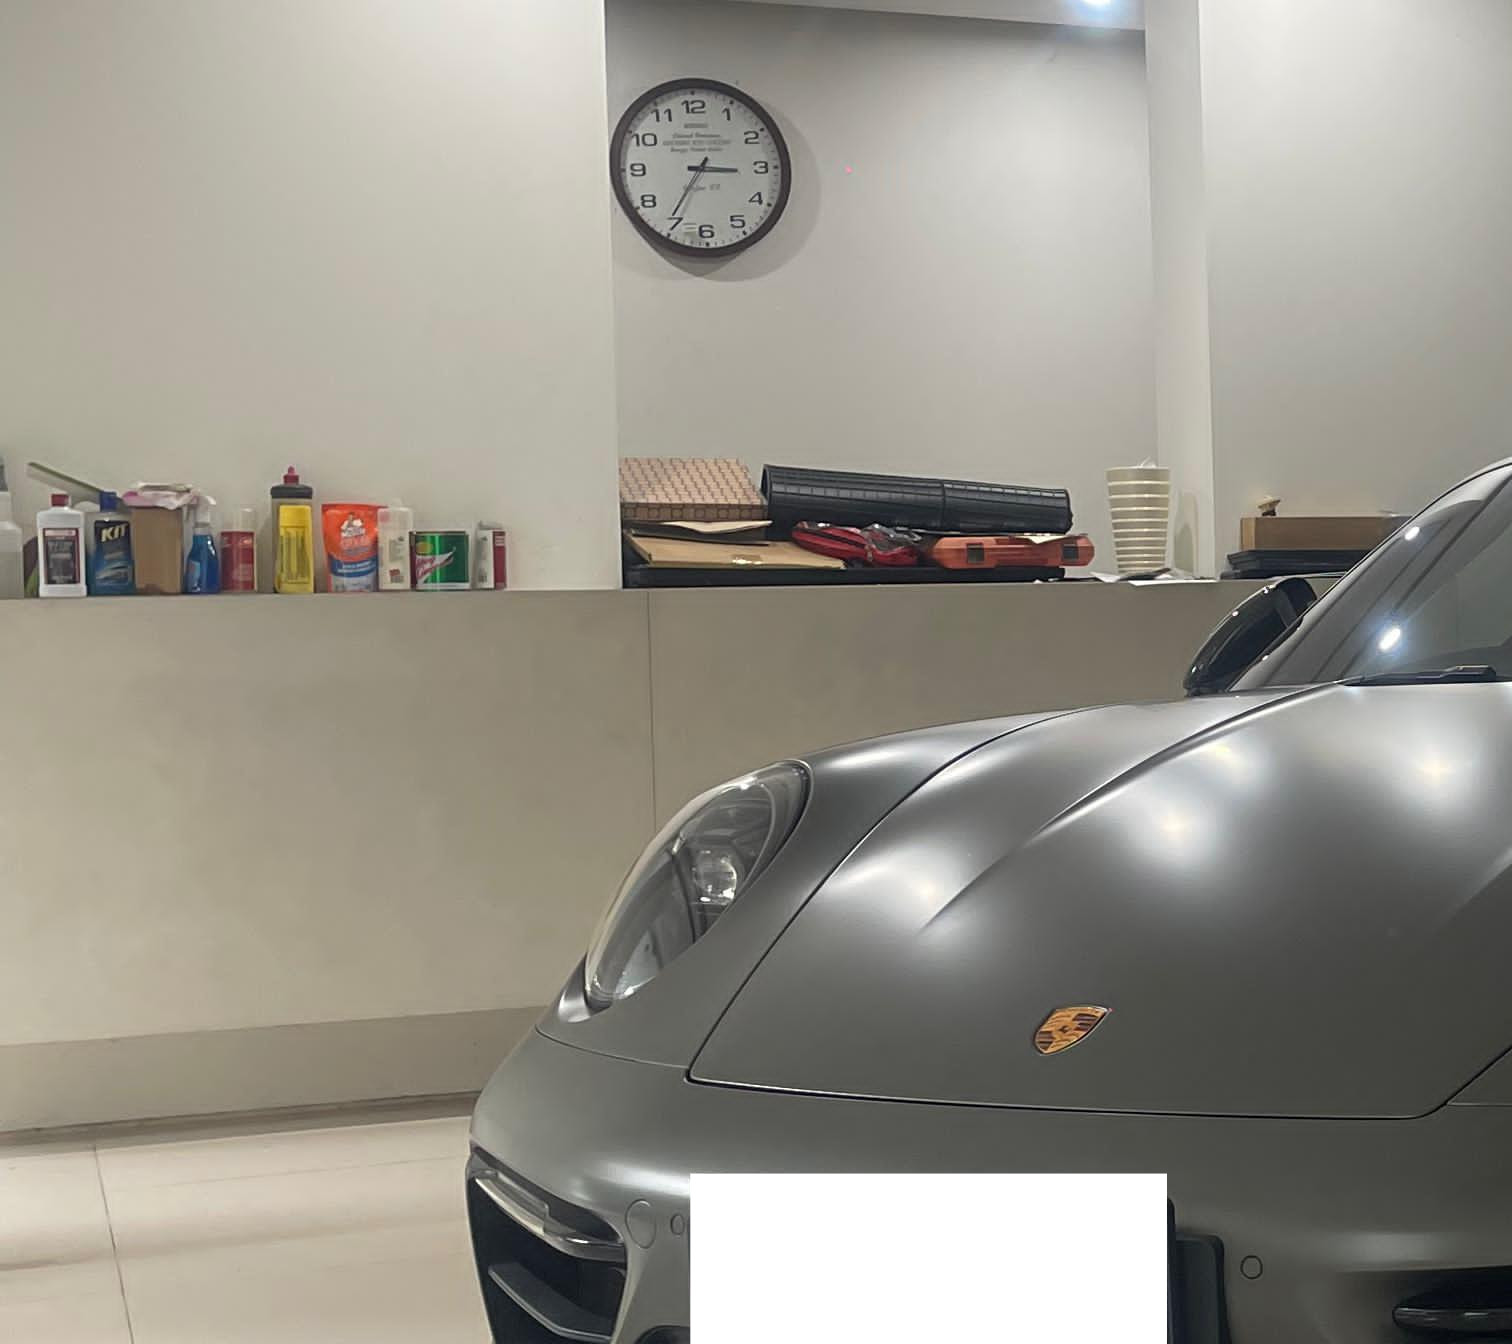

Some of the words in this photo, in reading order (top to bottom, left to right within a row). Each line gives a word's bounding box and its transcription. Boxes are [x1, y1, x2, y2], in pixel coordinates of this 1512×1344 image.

[681, 100, 706, 114] 12
[722, 107, 731, 121] 1
[651, 108, 673, 122] 11
[632, 133, 657, 147] 10
[744, 130, 759, 144] 2
[630, 163, 646, 177] 9
[753, 161, 769, 174] 3
[640, 194, 657, 208] 8
[748, 192, 763, 205] 4
[667, 217, 683, 231] 7
[730, 214, 746, 228] 5
[698, 224, 715, 238] 6
[101, 523, 129, 543] KIT
